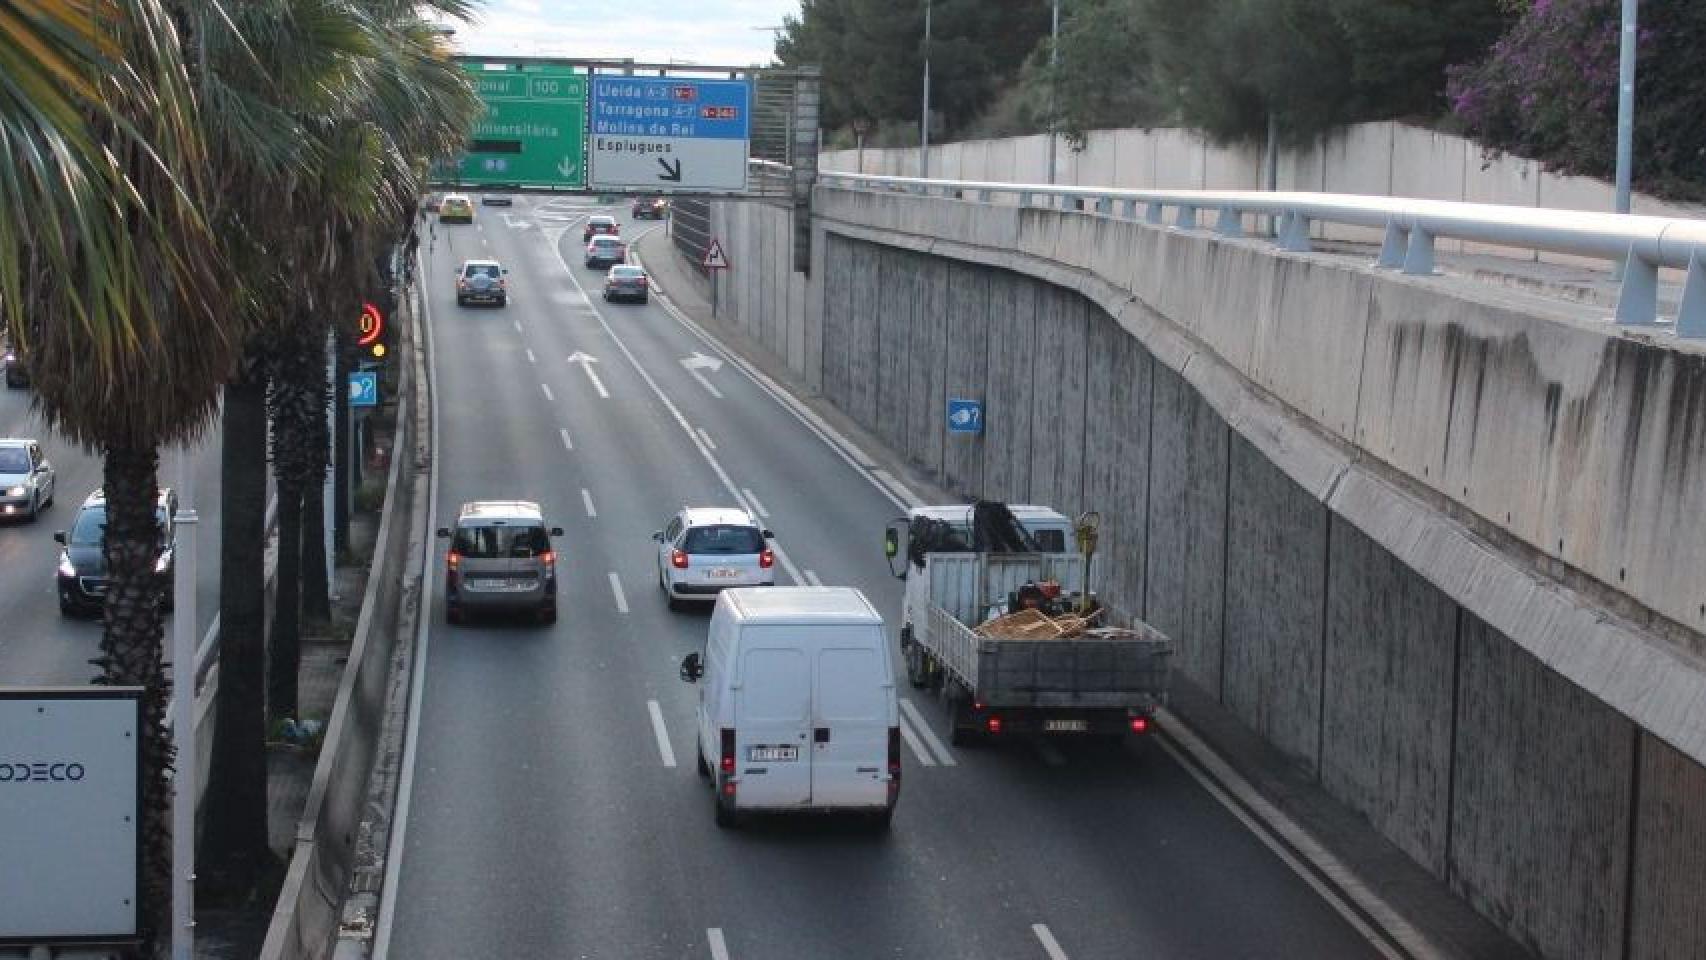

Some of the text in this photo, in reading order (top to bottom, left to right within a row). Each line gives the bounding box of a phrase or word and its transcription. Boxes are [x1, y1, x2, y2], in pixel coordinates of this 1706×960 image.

[534, 80, 559, 94] 100
[567, 83, 579, 95] m
[599, 83, 641, 98] Lleida
[599, 101, 669, 119] Tarragona
[597, 120, 695, 136] Molins de Rei
[597, 137, 672, 155] Esplugues
